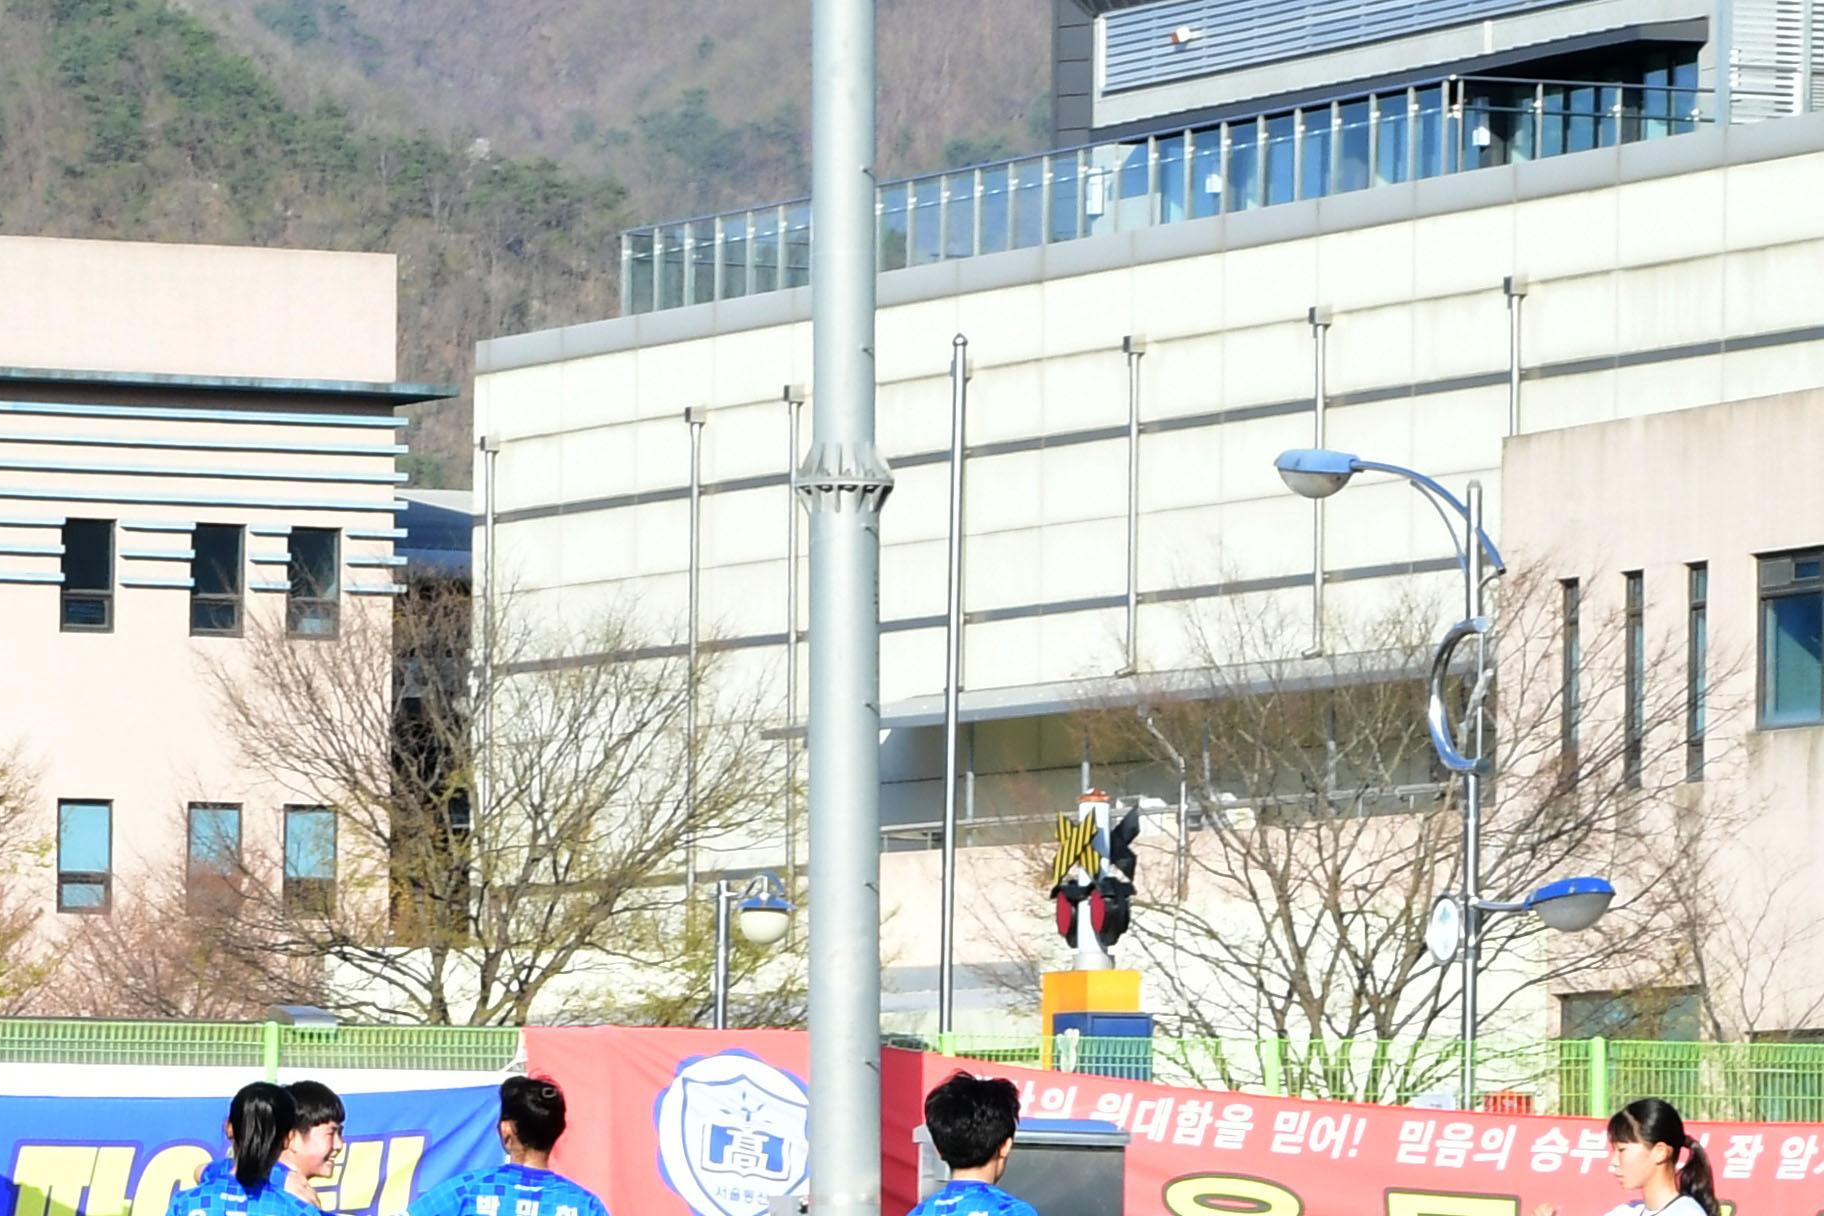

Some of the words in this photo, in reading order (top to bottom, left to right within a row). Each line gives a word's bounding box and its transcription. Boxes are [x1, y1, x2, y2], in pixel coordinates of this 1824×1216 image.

[1270, 1110, 1368, 1160] 믿어!
[1396, 1119, 1518, 1171] 믿음의
[1722, 1133, 1764, 1179] 잘
